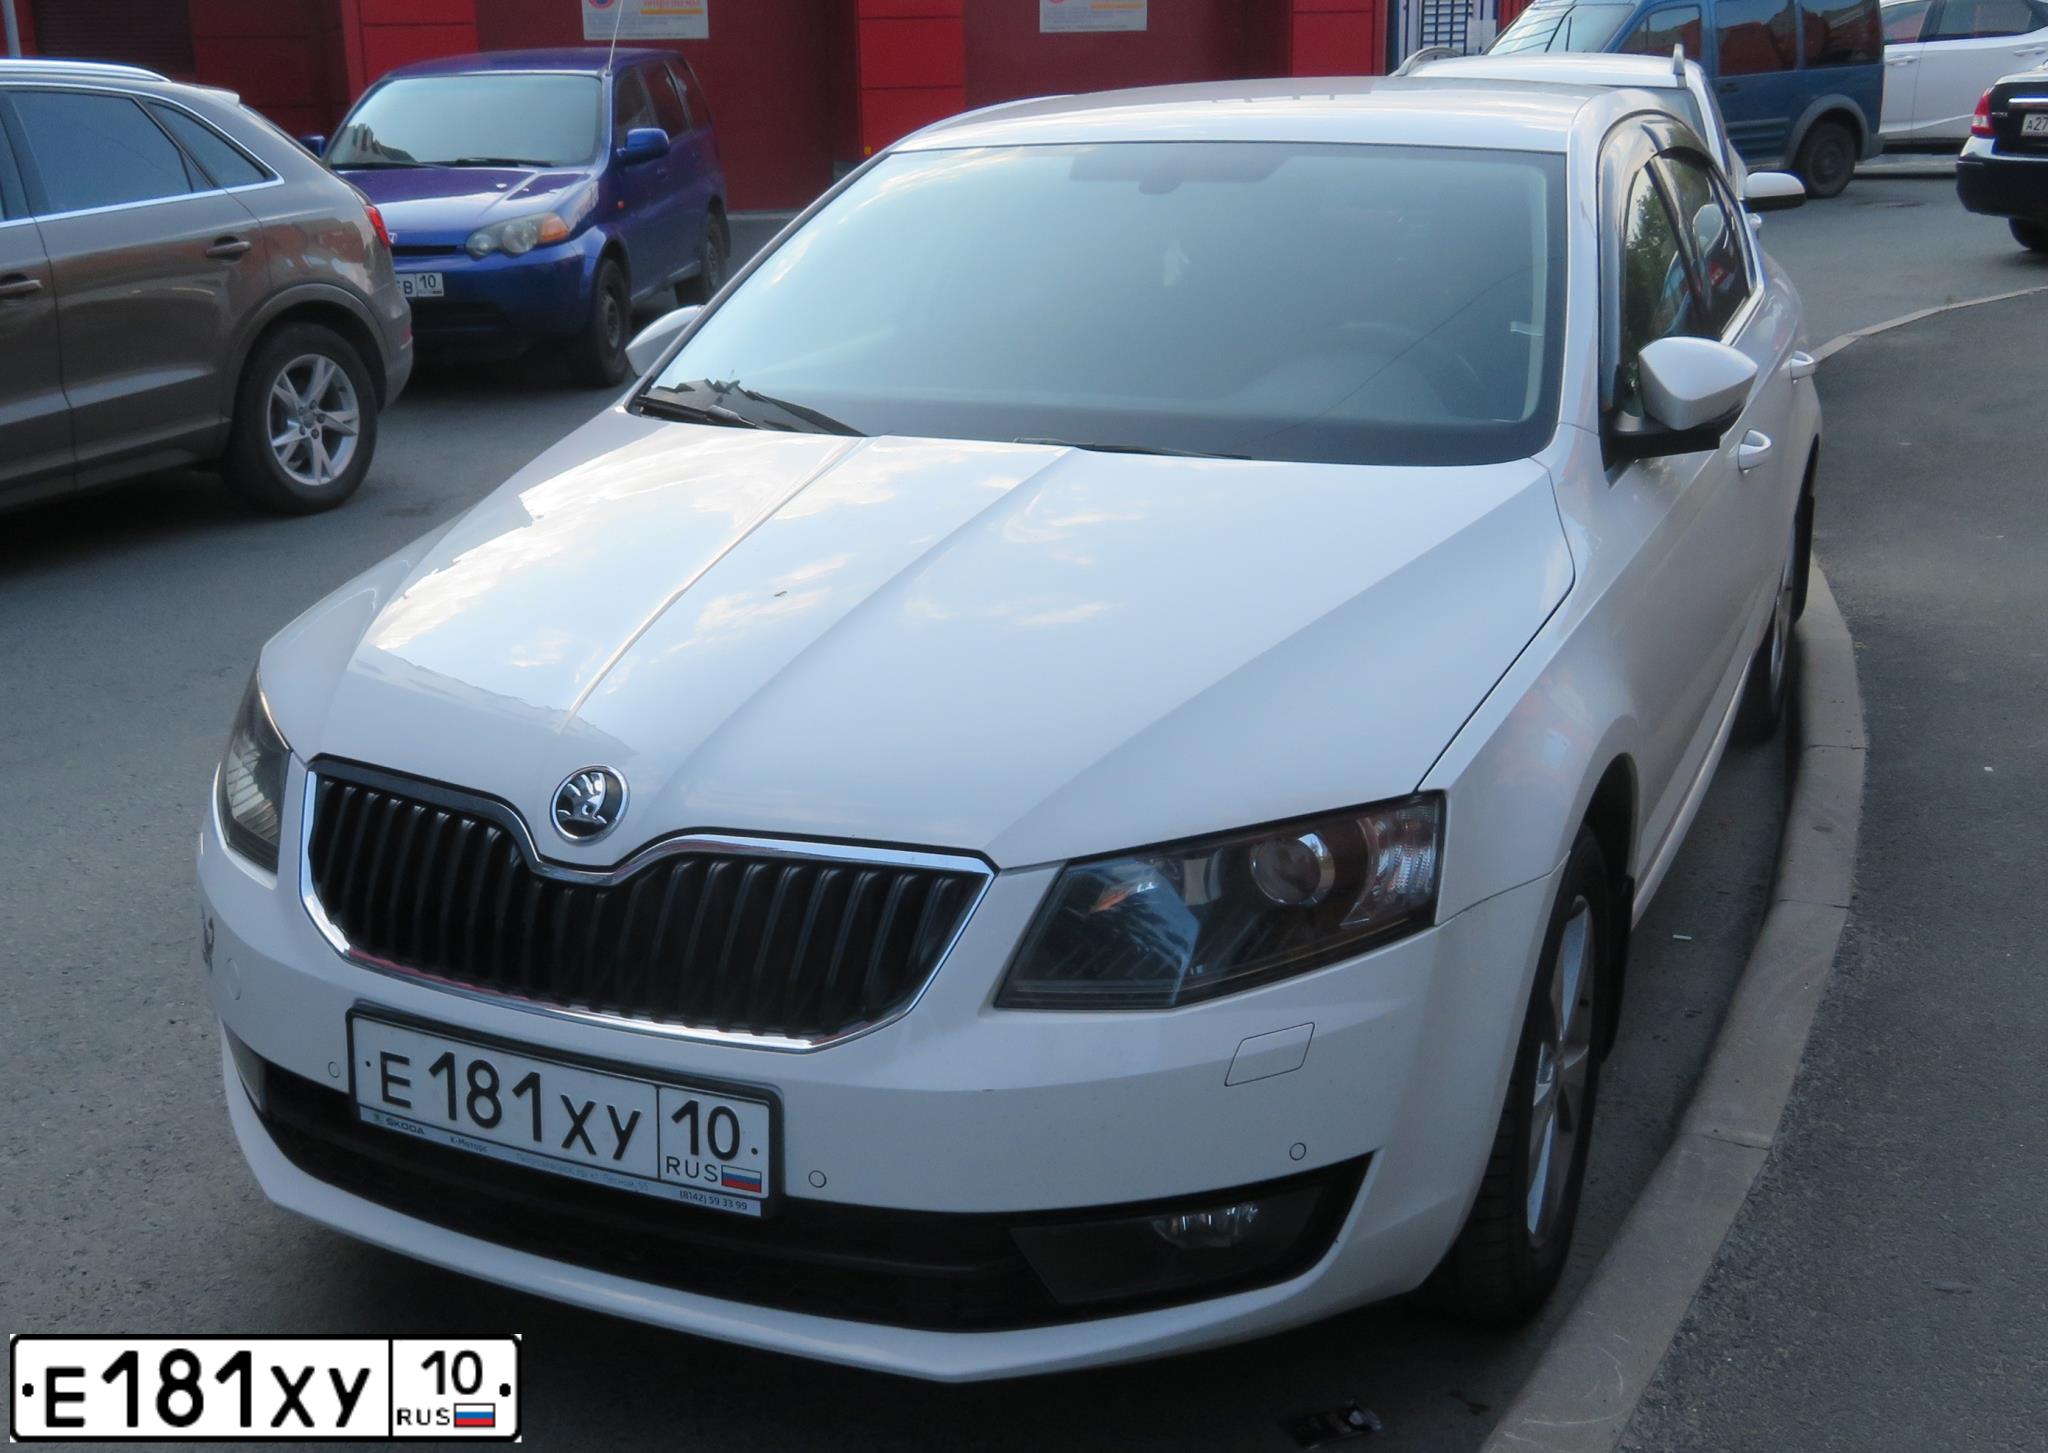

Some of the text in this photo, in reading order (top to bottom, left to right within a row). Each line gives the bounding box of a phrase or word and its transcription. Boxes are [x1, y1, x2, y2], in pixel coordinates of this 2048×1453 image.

[419, 275, 437, 289] 10
[671, 1099, 741, 1162] 10
[666, 1155, 718, 1183] RUS
